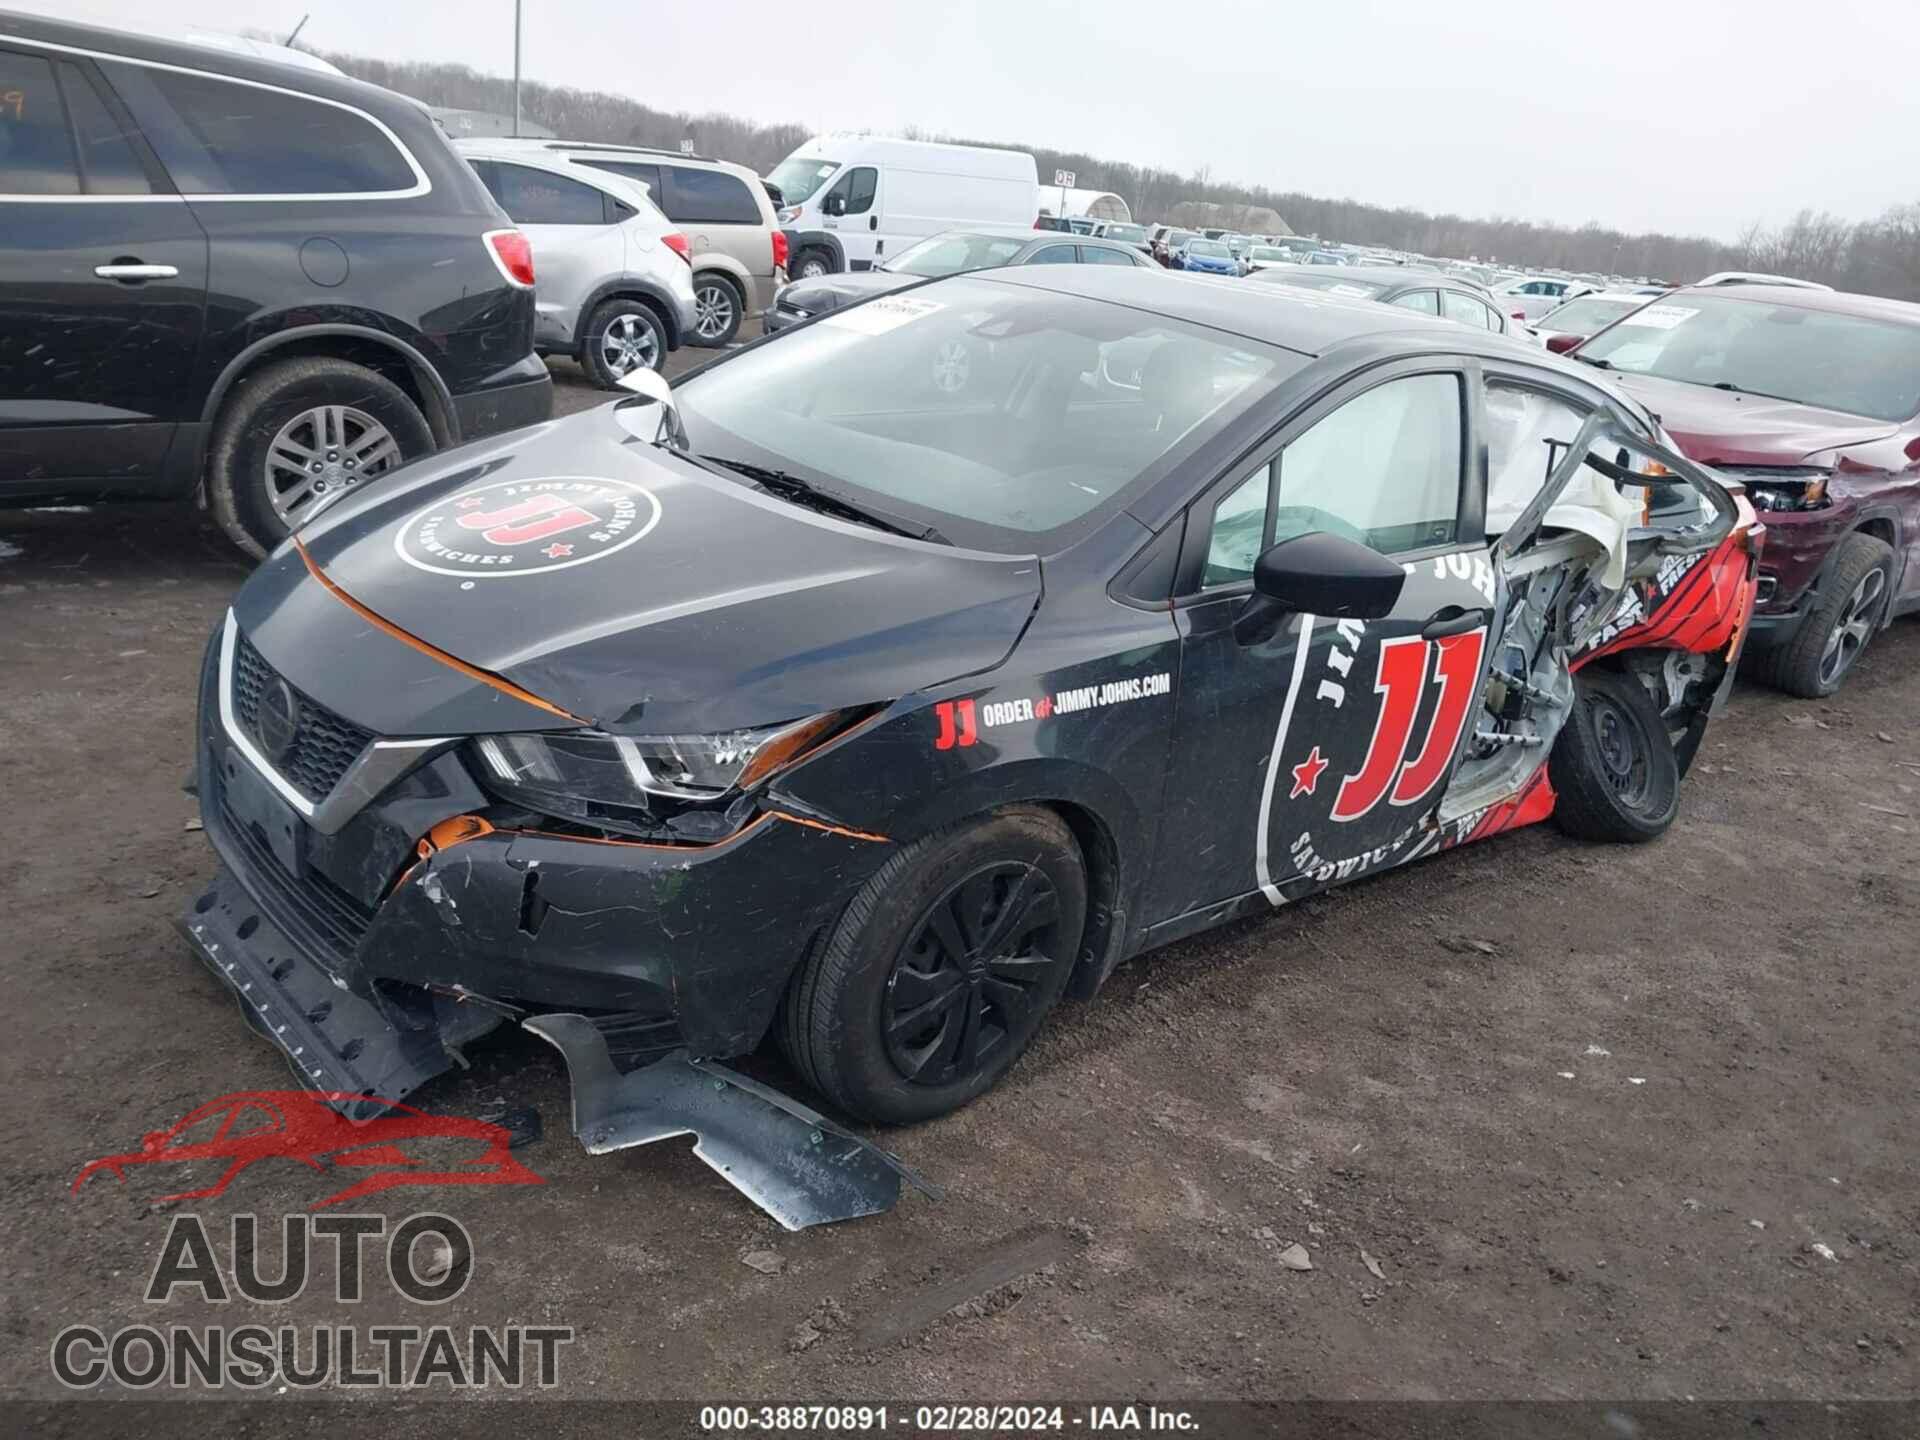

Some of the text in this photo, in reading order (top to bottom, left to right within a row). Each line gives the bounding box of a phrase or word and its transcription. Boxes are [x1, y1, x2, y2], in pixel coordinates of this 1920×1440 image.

[419, 516, 514, 564] SANDWICHES
[455, 493, 602, 546] JJ
[935, 697, 978, 750] JJ
[983, 698, 1035, 728] ORDER
[1329, 625, 1488, 822] JJ
